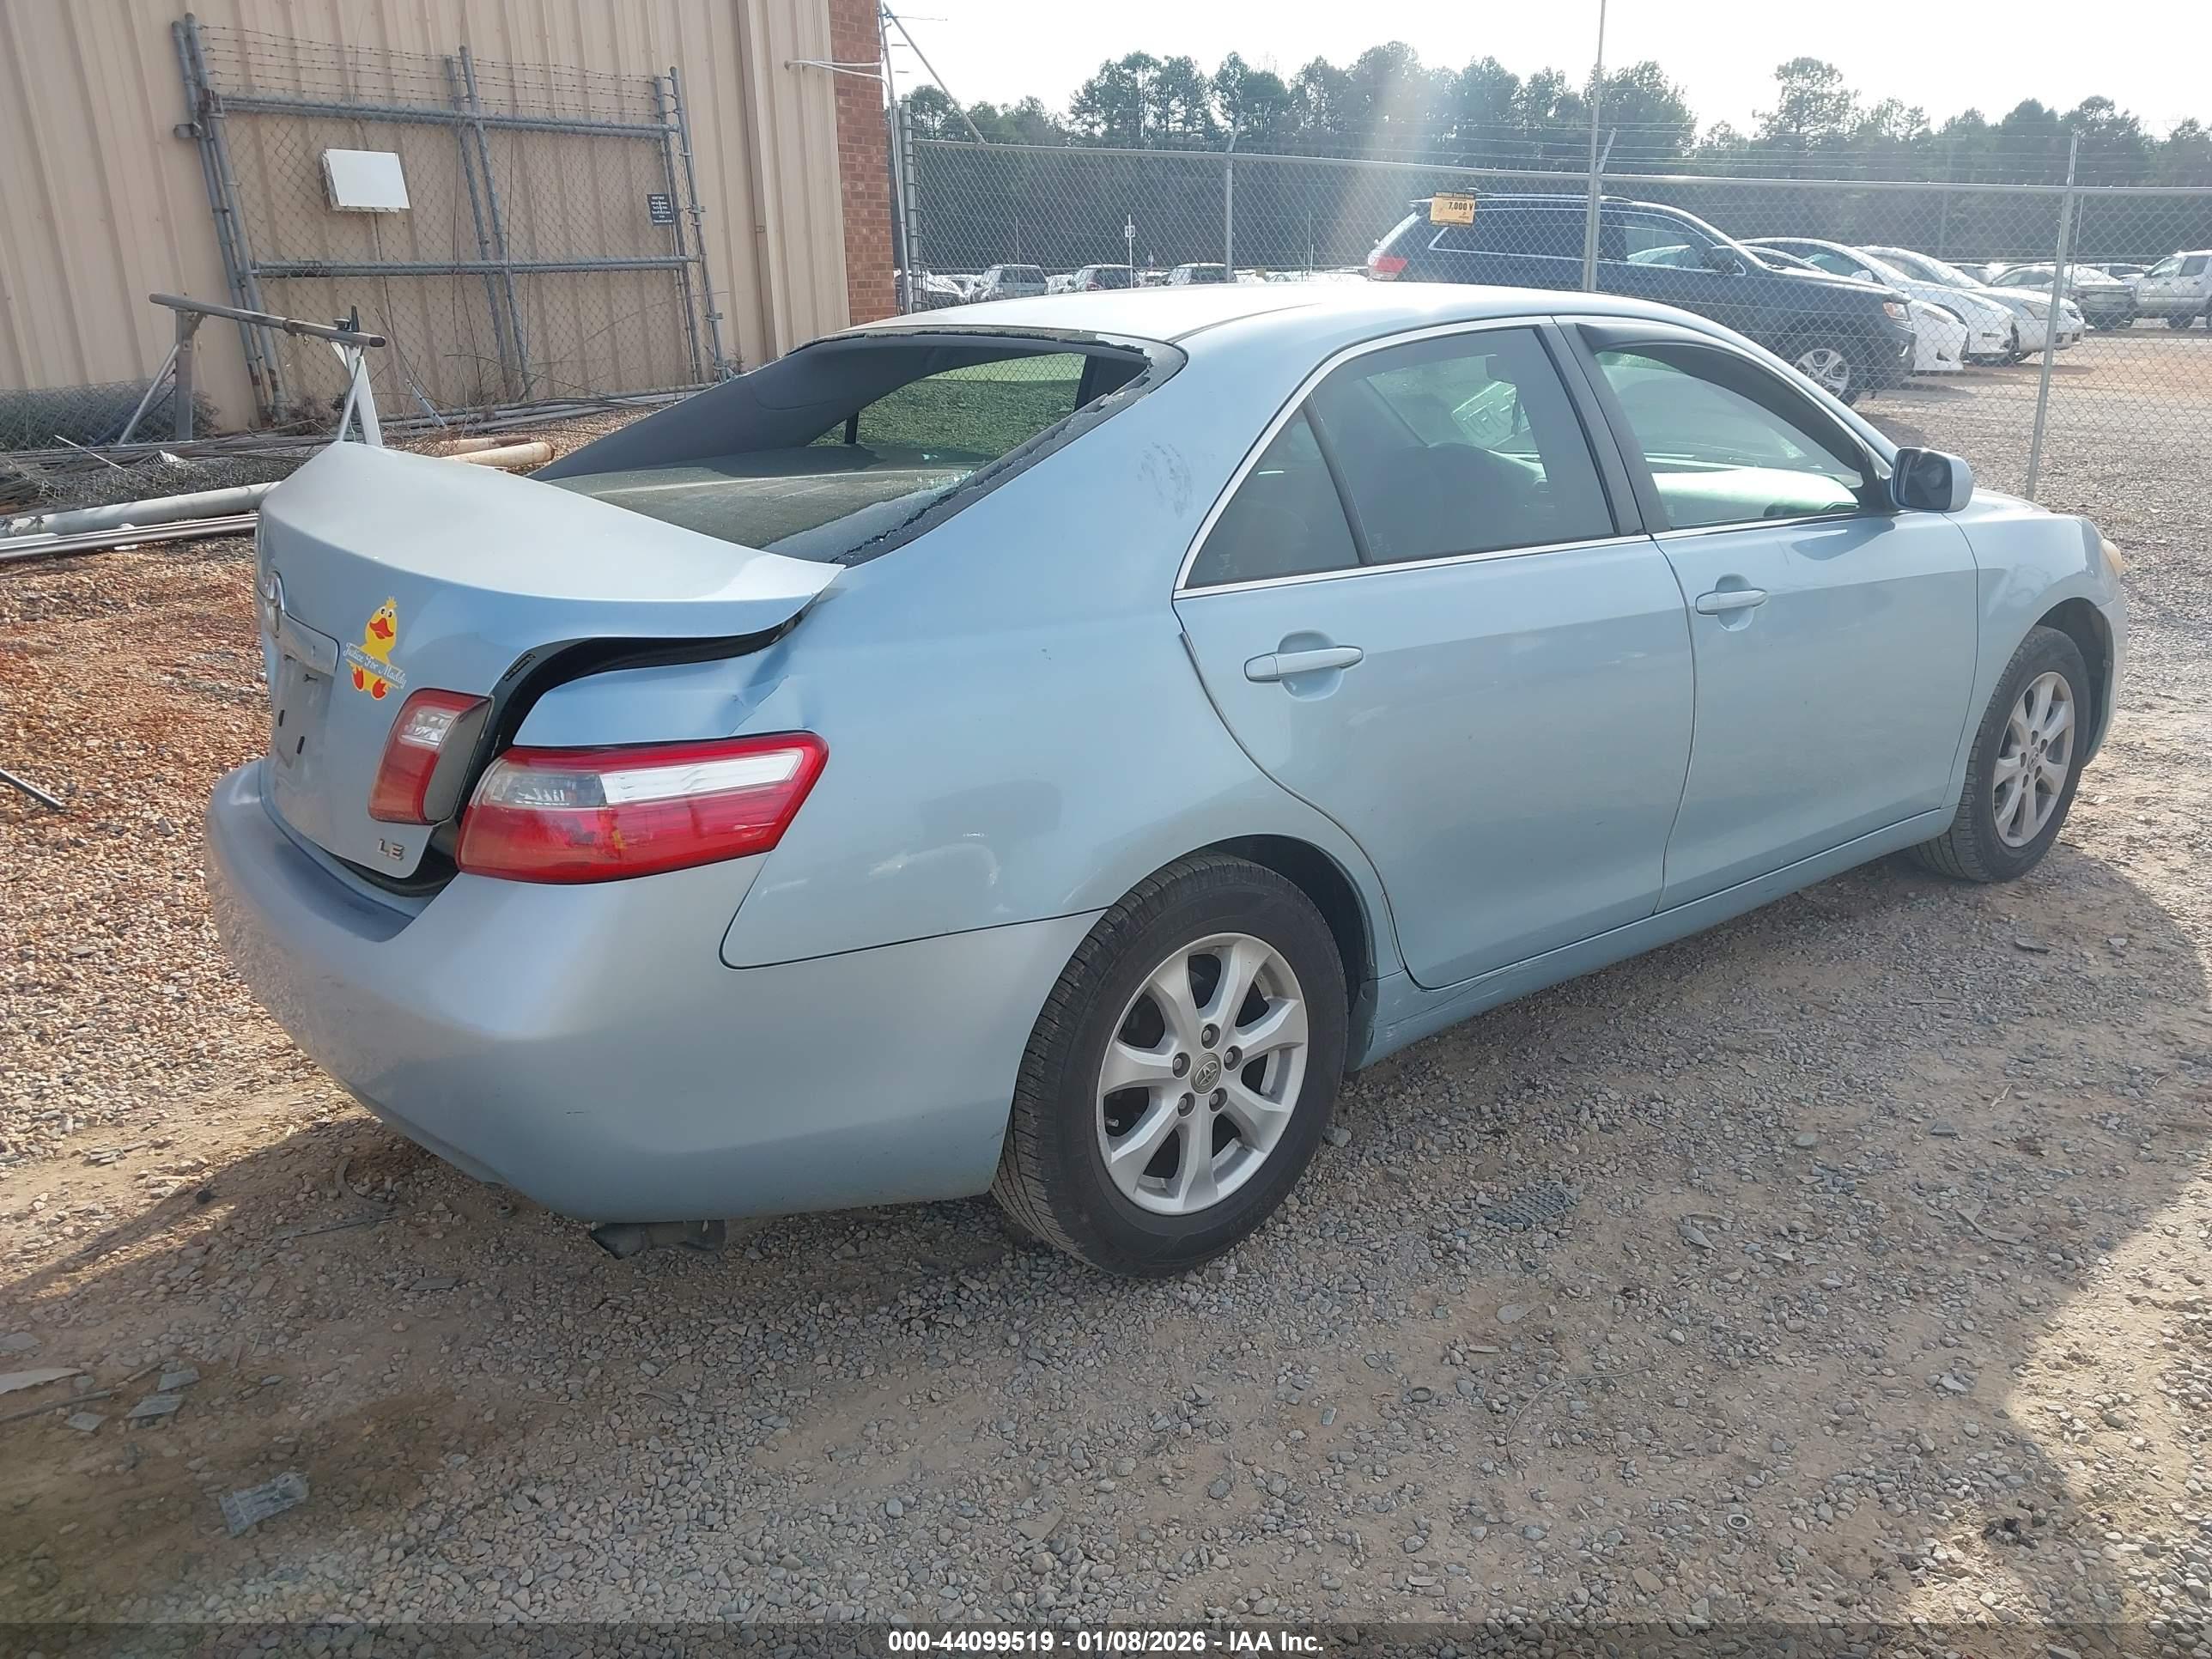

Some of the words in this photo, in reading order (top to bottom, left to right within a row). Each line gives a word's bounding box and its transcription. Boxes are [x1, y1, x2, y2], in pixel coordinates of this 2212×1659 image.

[1449, 202, 1468, 211] 7,000
[1469, 202, 1474, 211] V
[364, 654, 379, 670] For
[378, 664, 407, 690] Maddy
[378, 838, 405, 860] LE
